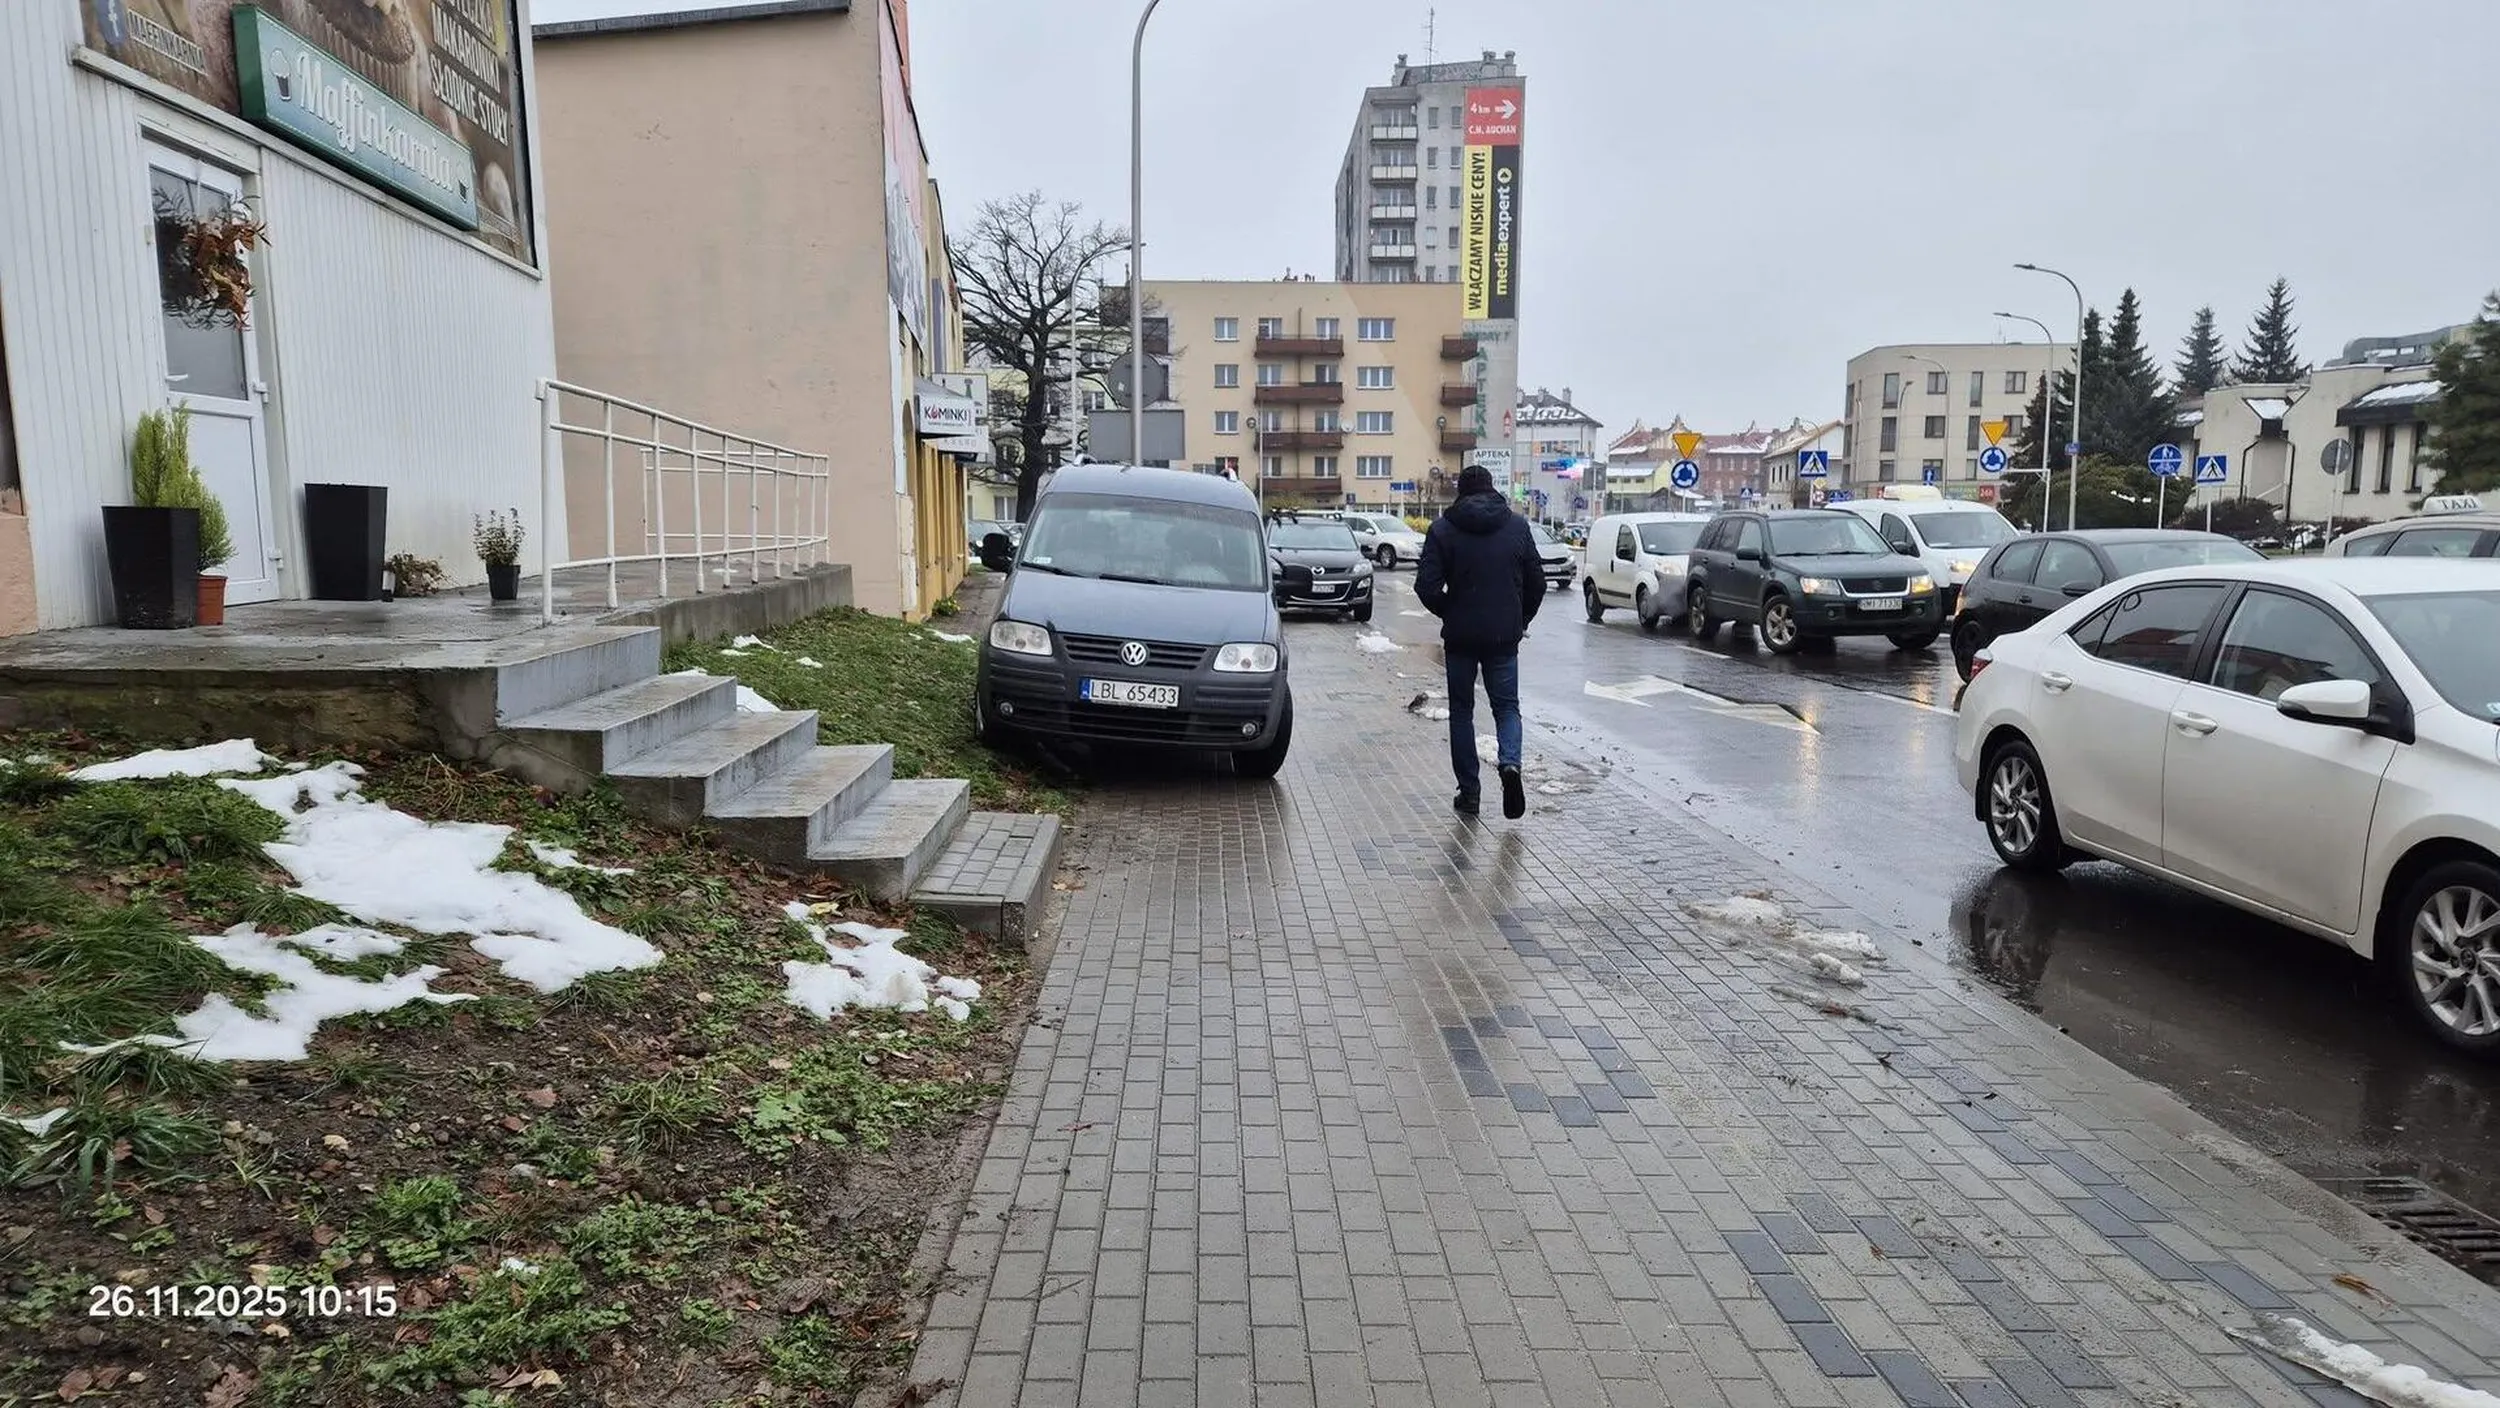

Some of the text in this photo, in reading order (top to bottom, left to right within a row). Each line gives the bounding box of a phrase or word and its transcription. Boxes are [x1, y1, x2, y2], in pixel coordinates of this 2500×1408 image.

[298, 52, 454, 192] Maffinkarnia
[1468, 152, 1486, 310] WŁĄCZAMY NISKIE CENY!
[1495, 186, 1512, 296] mediaexpert
[924, 404, 968, 420] KOMINKI
[1475, 450, 1510, 458] APTEKA
[2438, 498, 2479, 509] TAXI
[1091, 681, 1177, 704] LBL 65433
